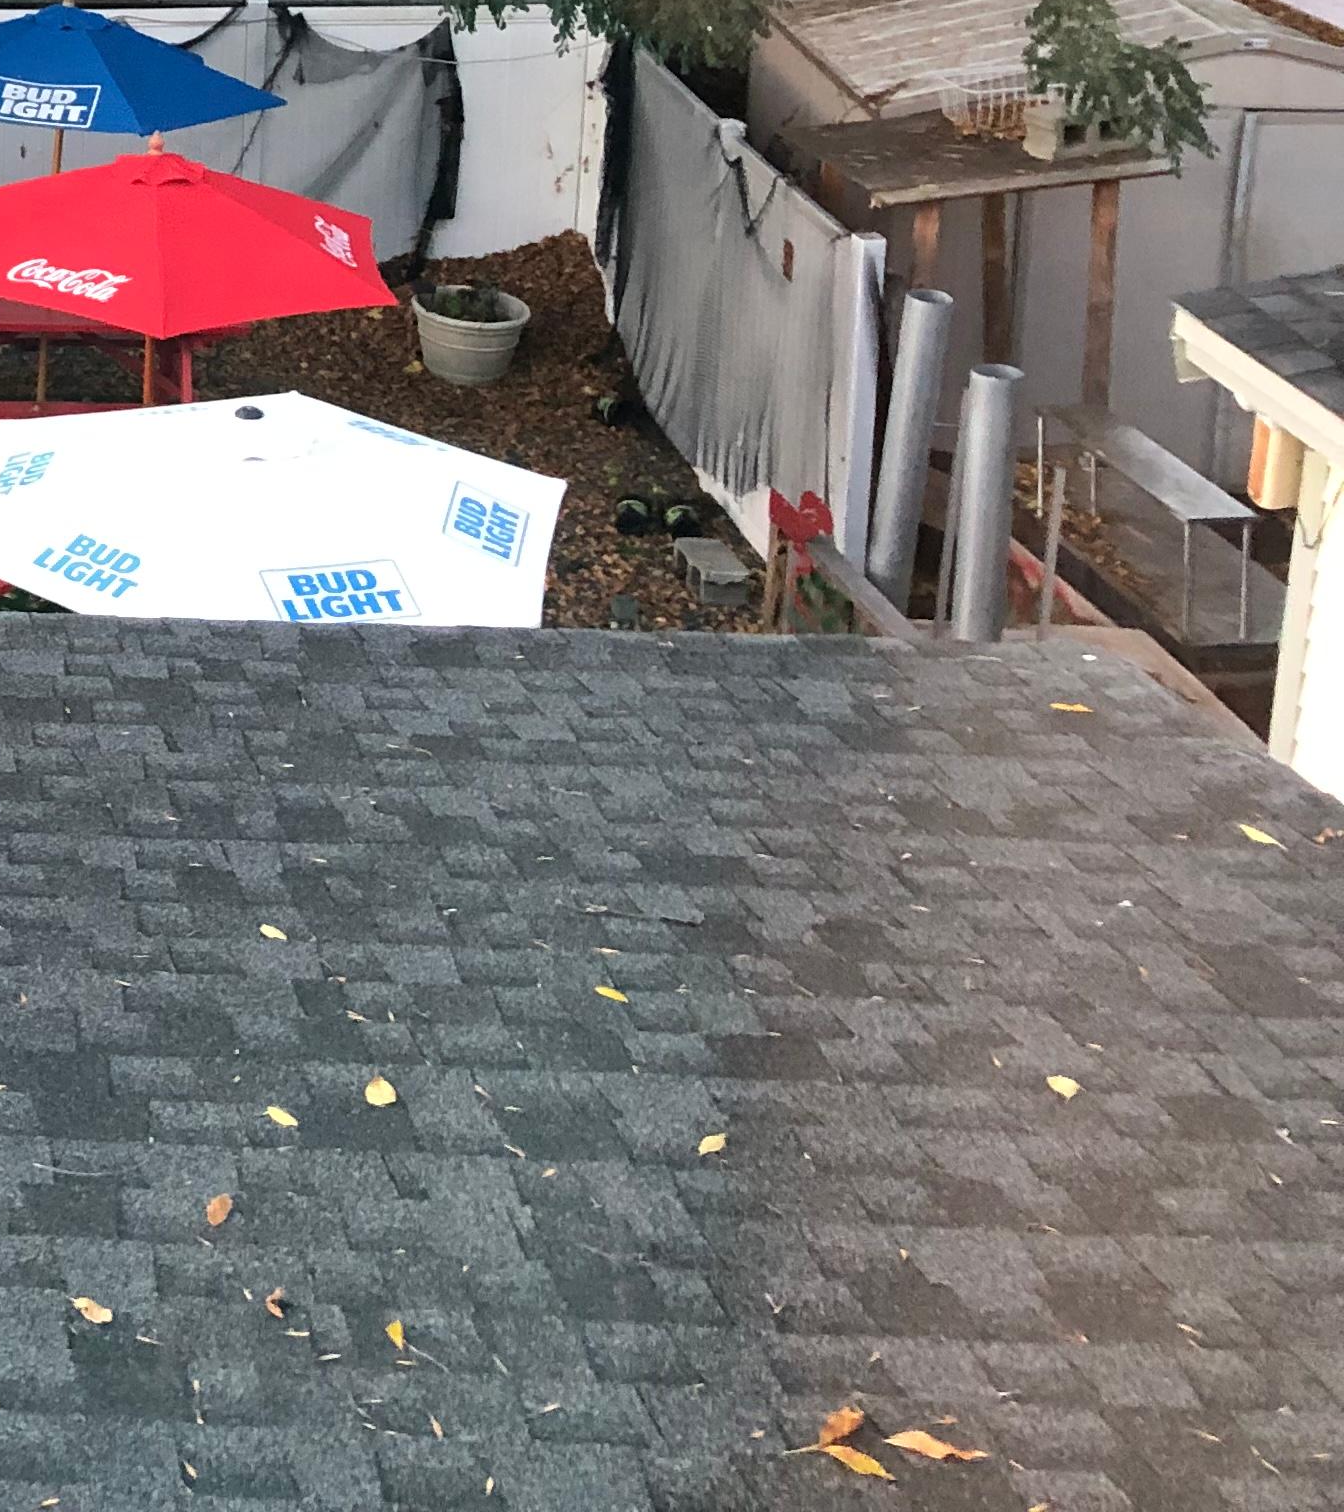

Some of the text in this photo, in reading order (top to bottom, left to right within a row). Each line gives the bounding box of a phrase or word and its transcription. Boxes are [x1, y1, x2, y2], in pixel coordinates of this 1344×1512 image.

[2, 83, 77, 105] BUD
[6, 257, 132, 303] Coca-Cola
[454, 496, 487, 540] BUD
[482, 501, 520, 560] LIGHT
[32, 547, 139, 598] LIGHT
[64, 533, 141, 574] BUD
[287, 569, 378, 597] BUD
[281, 589, 404, 623] LIGHT
